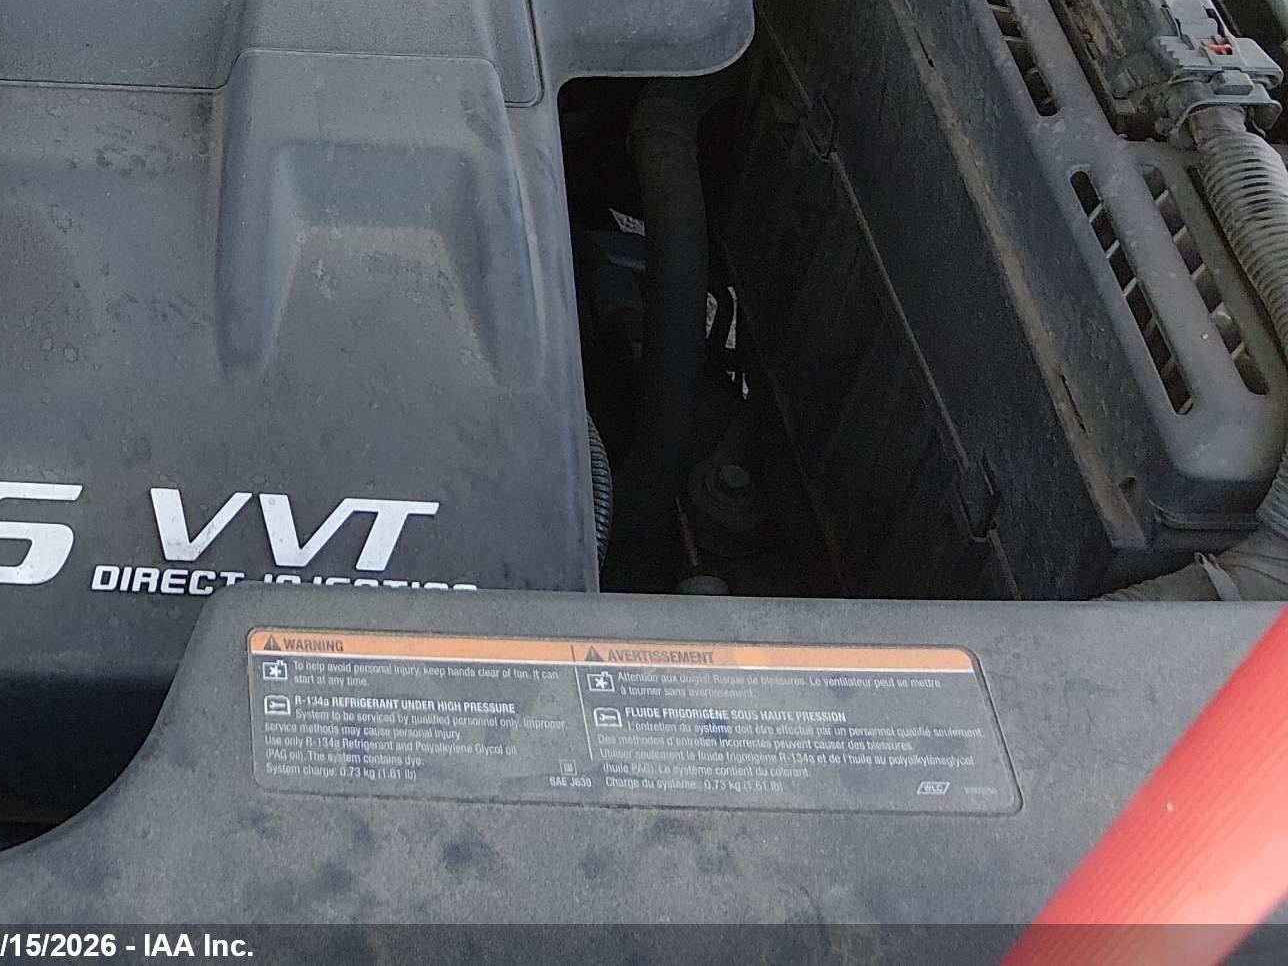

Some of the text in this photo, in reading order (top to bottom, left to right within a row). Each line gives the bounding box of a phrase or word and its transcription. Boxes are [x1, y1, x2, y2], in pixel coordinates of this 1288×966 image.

[150, 487, 440, 571] VVT
[284, 638, 344, 651] WARNING
[608, 650, 713, 663] AVERTISSEMENT
[294, 661, 303, 671] To
[306, 661, 325, 672] help
[327, 662, 351, 672] avoid
[354, 663, 391, 674] personal
[424, 666, 445, 677] keep
[448, 667, 475, 676] hands
[478, 668, 499, 677] clear
[502, 669, 511, 678] of
[514, 669, 531, 678] fan.
[294, 675, 369, 687] start at any time.
[618, 672, 658, 683] Attention
[661, 674, 677, 683] aux
[747, 675, 758, 684] de
[809, 677, 822, 686] Le
[823, 677, 871, 688] ventilateur
[874, 679, 894, 688] peut
[897, 679, 908, 687] se
[911, 679, 941, 688] mettre
[628, 686, 662, 696] tourner
[665, 688, 686, 696] sans
[295, 697, 515, 713] R-134a REFRIGERANT UNDER HIGH PRESSURE
[296, 710, 329, 720] System
[332, 711, 341, 720] to
[343, 711, 354, 720] be
[357, 712, 395, 723] serviced
[398, 714, 408, 725] by
[411, 714, 450, 725] qualified
[524, 718, 566, 730] Improper
[625, 707, 661, 717] FLUIDE
[731, 710, 758, 720] SOUS
[761, 711, 793, 720] HAUTE
[796, 712, 846, 722] PRESSION
[265, 722, 463, 740] service methods may cause personal injury.
[628, 721, 677, 732] L'entretien
[679, 722, 692, 732] du
[694, 723, 732, 734] système
[735, 725, 753, 734] doit
[816, 728, 831, 737] par
[834, 727, 846, 736] un
[849, 727, 894, 737] personnel
[265, 736, 517, 755] Use only R-134a Refrigerant and Polyalkylene Glycol oil
[598, 734, 616, 744] Des
[720, 739, 772, 749] incorrectes
[774, 740, 812, 750] peuvent
[814, 742, 844, 750] causer
[848, 740, 865, 750] des
[266, 748, 287, 760] (PAG
[308, 751, 325, 761] The
[363, 754, 402, 765] contains
[405, 756, 424, 767] dye.
[687, 750, 695, 760] le
[698, 750, 723, 761] fluide
[779, 753, 815, 763] R-134a
[817, 754, 826, 763] et
[829, 754, 841, 764] de
[875, 756, 886, 765] au
[266, 762, 300, 774] System
[364, 767, 375, 779] kg
[405, 769, 416, 781] lb)
[715, 767, 754, 776] contient
[756, 768, 767, 776] du
[550, 776, 567, 786] SAE
[605, 776, 639, 788] Charge
[642, 778, 654, 788] du
[729, 780, 741, 792] kg
